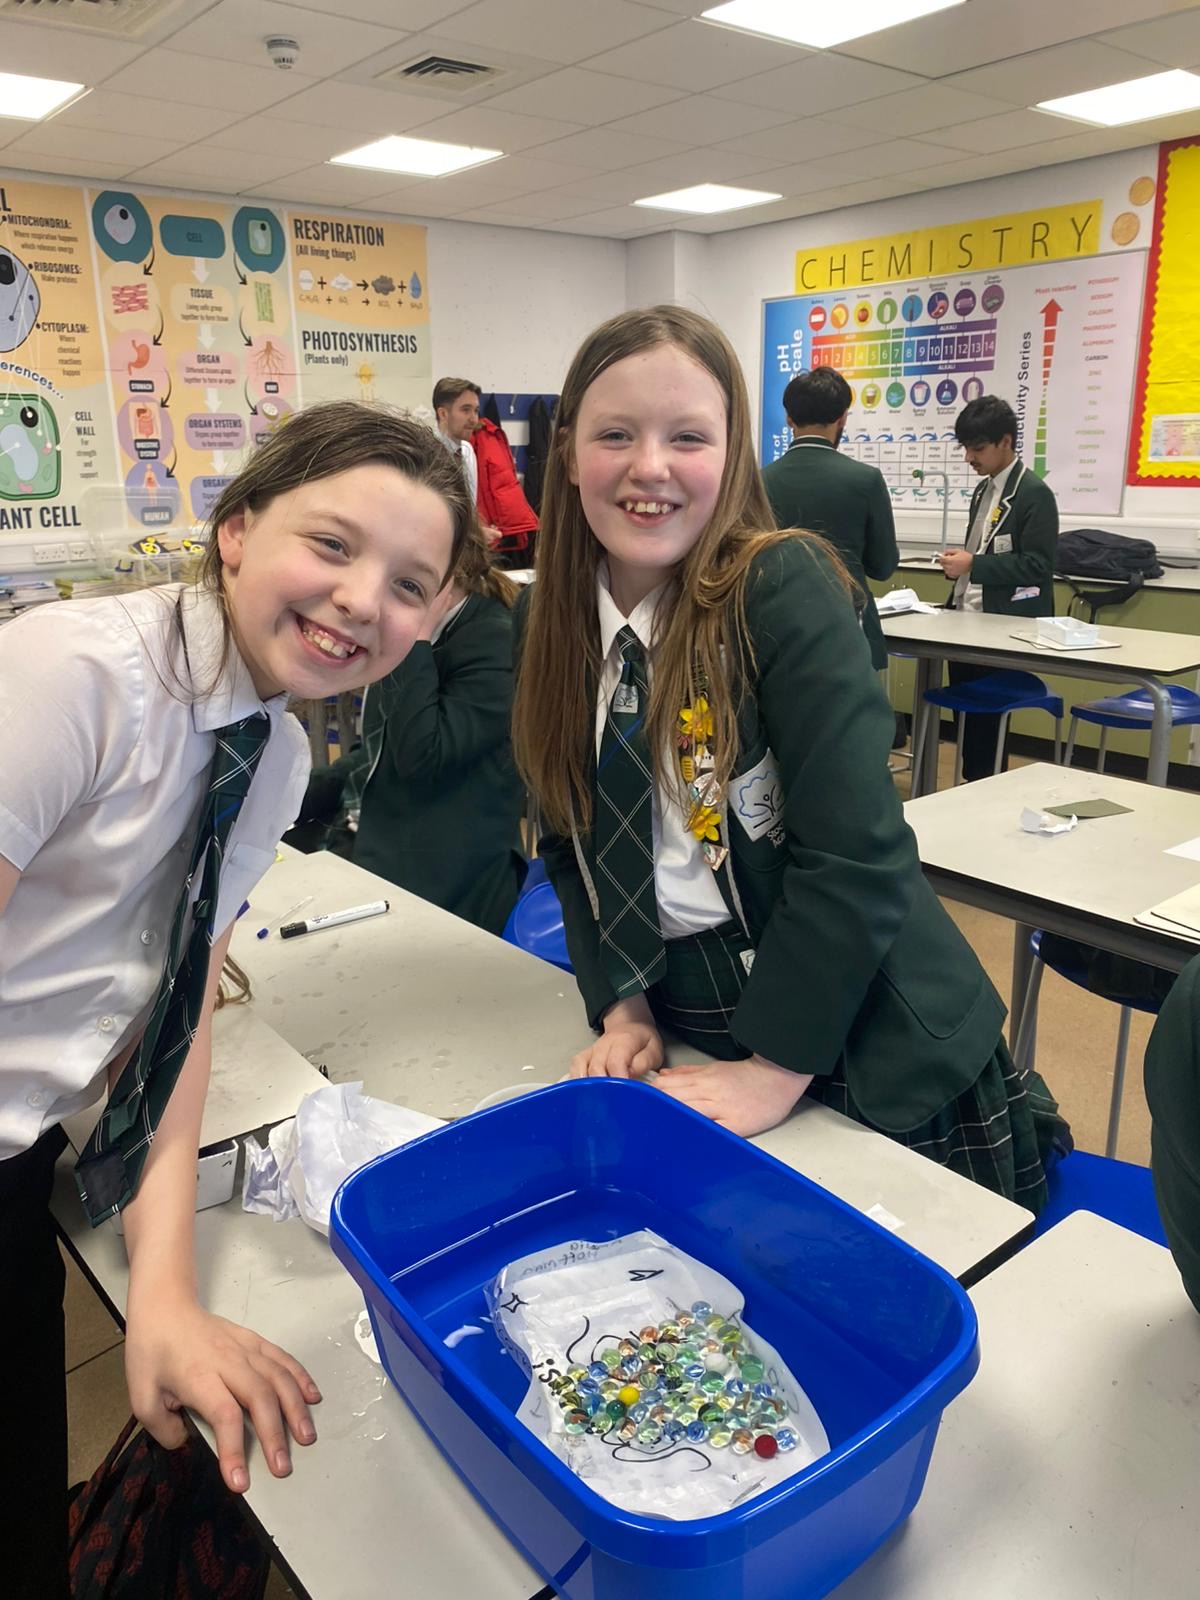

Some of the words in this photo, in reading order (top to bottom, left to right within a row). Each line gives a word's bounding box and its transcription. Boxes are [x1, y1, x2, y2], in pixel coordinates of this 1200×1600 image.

[7, 214, 72, 229] MITOCHONDRIA:
[294, 219, 384, 246] RESPIRATION
[311, 246, 330, 260] living
[331, 248, 356, 261] things)
[801, 214, 1092, 289] CHEMISTRY
[33, 261, 83, 274] RIBOSOMES:
[42, 322, 89, 333] CYTOPLASM:
[302, 330, 417, 353] PHOTOSYNTHESIS
[304, 353, 329, 365] (Plants
[777, 345, 791, 372] pH
[813, 356, 820, 365] 0
[825, 354, 829, 363] 1
[836, 353, 841, 362] 2
[847, 352, 852, 362] 3
[871, 351, 876, 360] 5
[882, 351, 888, 360] 6
[894, 349, 900, 358] 7
[906, 348, 912, 357] 8
[920, 347, 925, 356] 9
[931, 346, 940, 356] 10
[945, 345, 953, 355] 11
[958, 344, 968, 354] 12
[972, 343, 981, 353] 13
[985, 341, 994, 352] 14
[1018, 331, 1031, 380] Series
[75, 411, 93, 421] CELL
[76, 426, 96, 436] WALL
[188, 419, 212, 429] ORGAN
[214, 419, 242, 429] SYSTEMS
[773, 434, 781, 450] of
[40, 505, 82, 528] CELL
